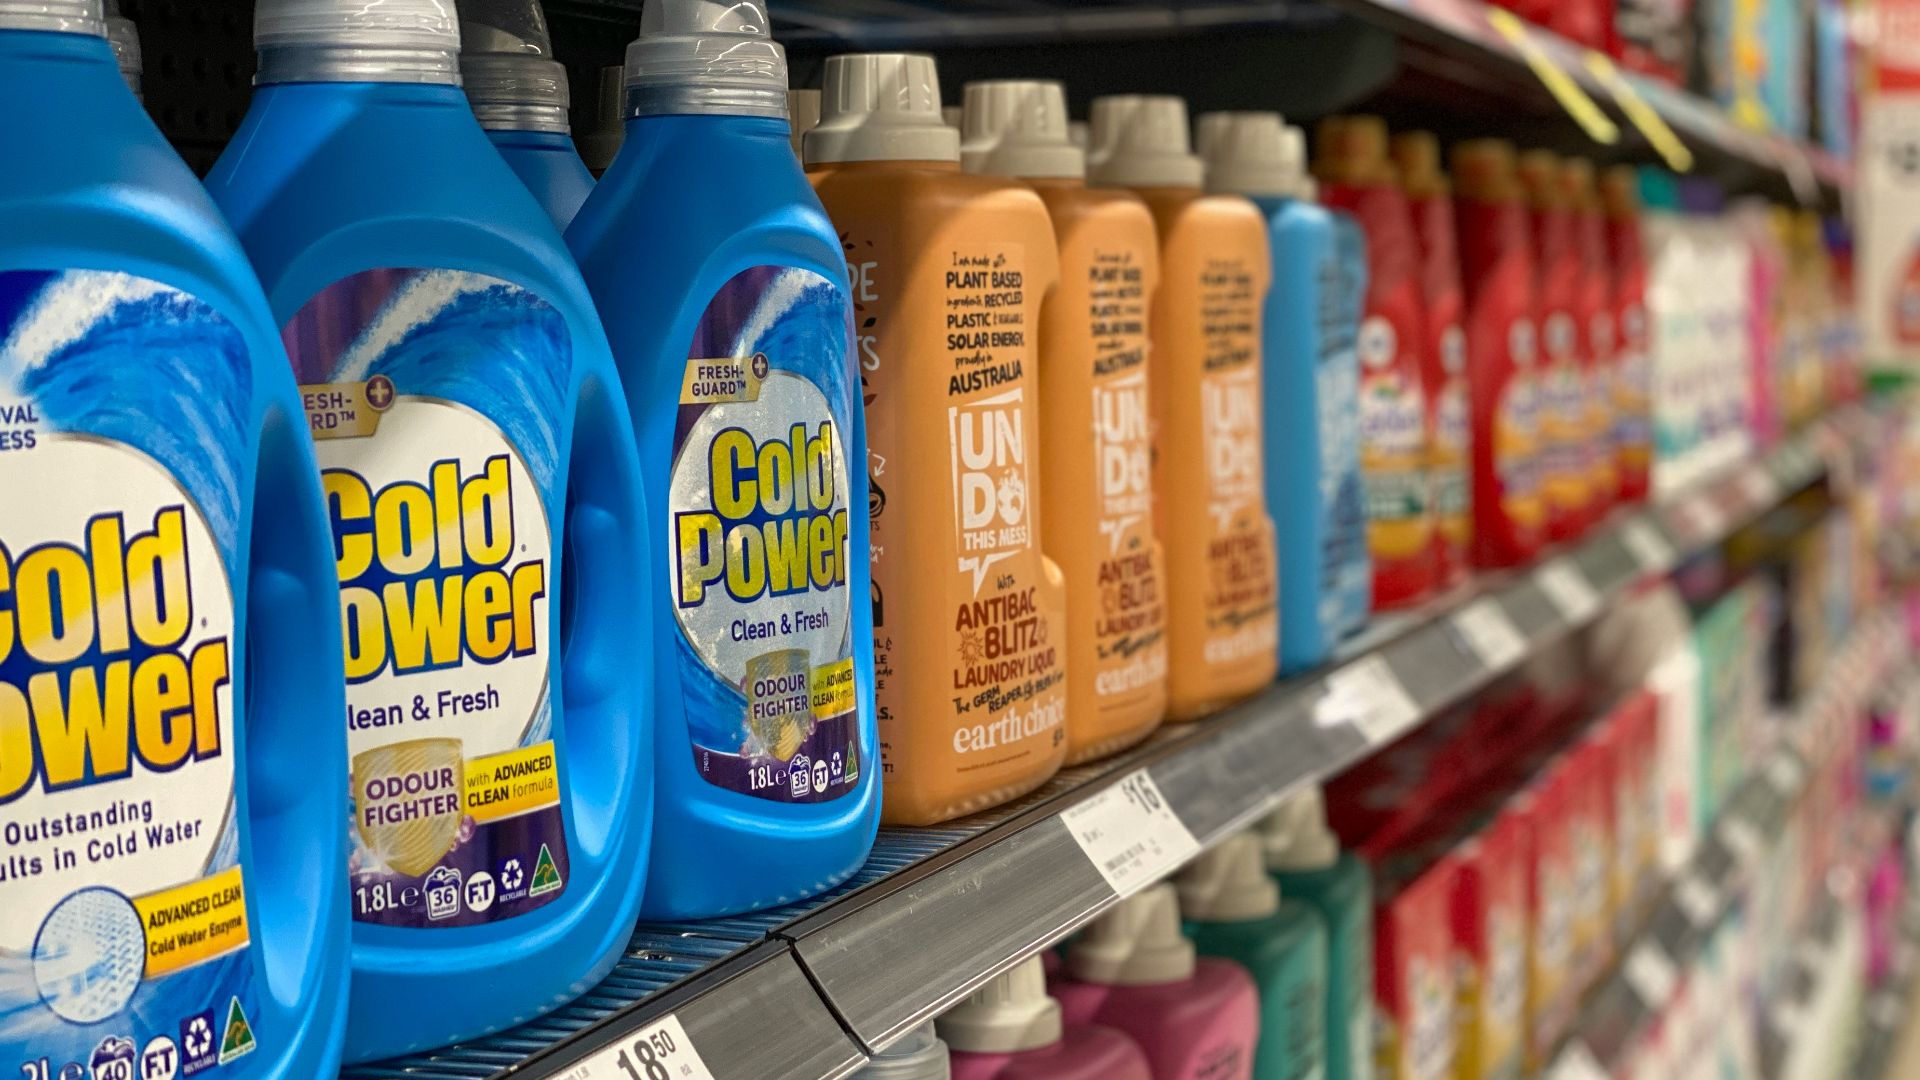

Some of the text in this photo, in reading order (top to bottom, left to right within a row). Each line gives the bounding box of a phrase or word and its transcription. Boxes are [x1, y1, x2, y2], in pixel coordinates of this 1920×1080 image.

[946, 271, 1022, 289] PLANT BASED
[984, 291, 1023, 308] RECYCLED
[947, 312, 991, 329] PLASTIC
[947, 331, 989, 351] SOLAR
[697, 364, 745, 381] FRESH-
[948, 359, 1023, 396] AUSTRALIA
[960, 409, 1023, 470] UN
[707, 420, 835, 522] Cold
[963, 525, 1026, 551] THIS MESS
[675, 508, 848, 609] Power
[731, 607, 829, 642] Clean & Fresh
[956, 586, 1036, 632] ANTIBAC
[984, 616, 1038, 660] BLITZ
[953, 656, 1025, 690] LAUNDRY
[1028, 646, 1056, 676] LIQUID
[754, 673, 805, 698] ODOUR
[812, 690, 835, 708] CLEAN
[952, 697, 970, 715] The
[972, 685, 1000, 708] GERM
[988, 684, 1022, 714] REAPER
[411, 695, 430, 721] &
[438, 684, 499, 718] Fresh
[753, 695, 809, 720] FIGHTER
[365, 767, 454, 800] ODOUR
[467, 755, 552, 788] with ADVANCED
[794, 771, 806, 787] 36
[468, 776, 553, 808] CLEAN formula
[5, 800, 152, 846] Outstanding
[364, 793, 459, 827] FIGHTER
[54, 848, 77, 871] in
[87, 831, 137, 863] Cold
[146, 819, 202, 850] Water
[149, 885, 241, 929] ADVANCED CLEAN
[433, 887, 454, 907] 36
[150, 916, 242, 956] Cold Water Enzyme
